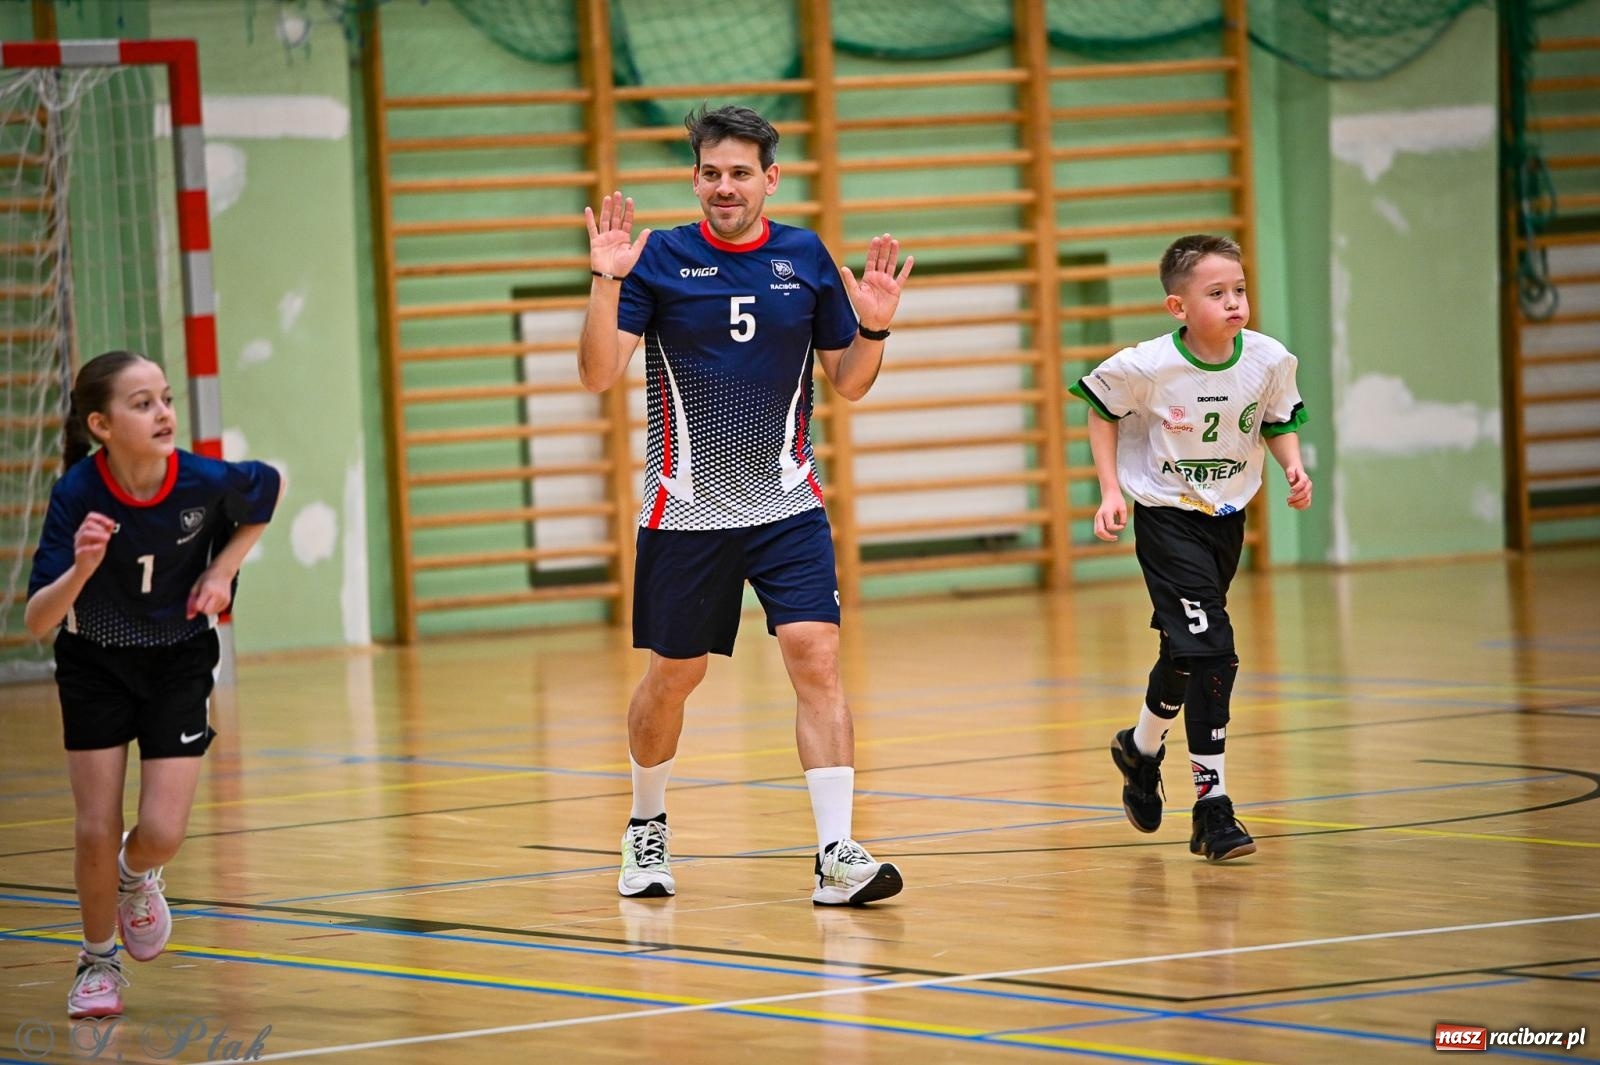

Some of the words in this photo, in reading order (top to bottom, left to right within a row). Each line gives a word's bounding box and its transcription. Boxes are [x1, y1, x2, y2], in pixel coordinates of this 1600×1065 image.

[730, 296, 756, 342] 5
[1202, 412, 1220, 442] 2
[137, 554, 154, 593] 1
[1180, 598, 1208, 634] 5
